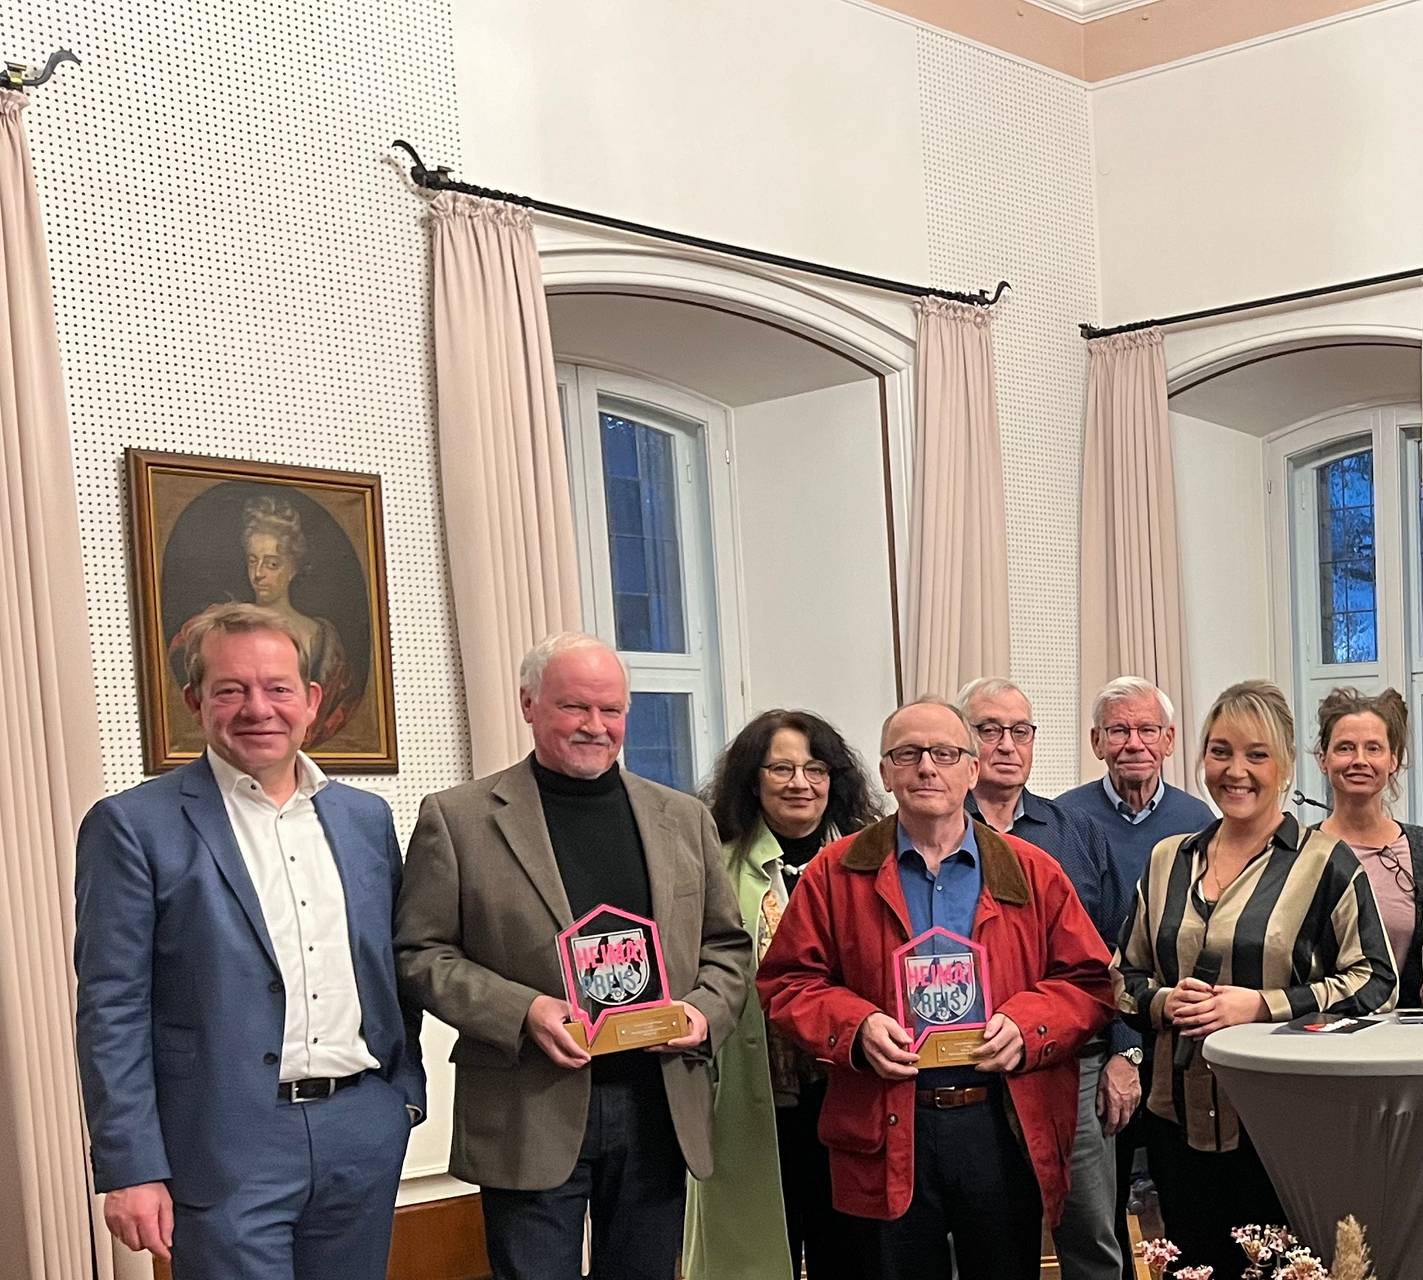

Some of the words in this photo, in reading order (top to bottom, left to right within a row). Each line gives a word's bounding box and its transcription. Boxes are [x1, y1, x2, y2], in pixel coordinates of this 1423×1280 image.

[576, 938, 646, 971] HEIMAT
[581, 969, 637, 997] PREIS
[908, 962, 973, 987] HEIMAT
